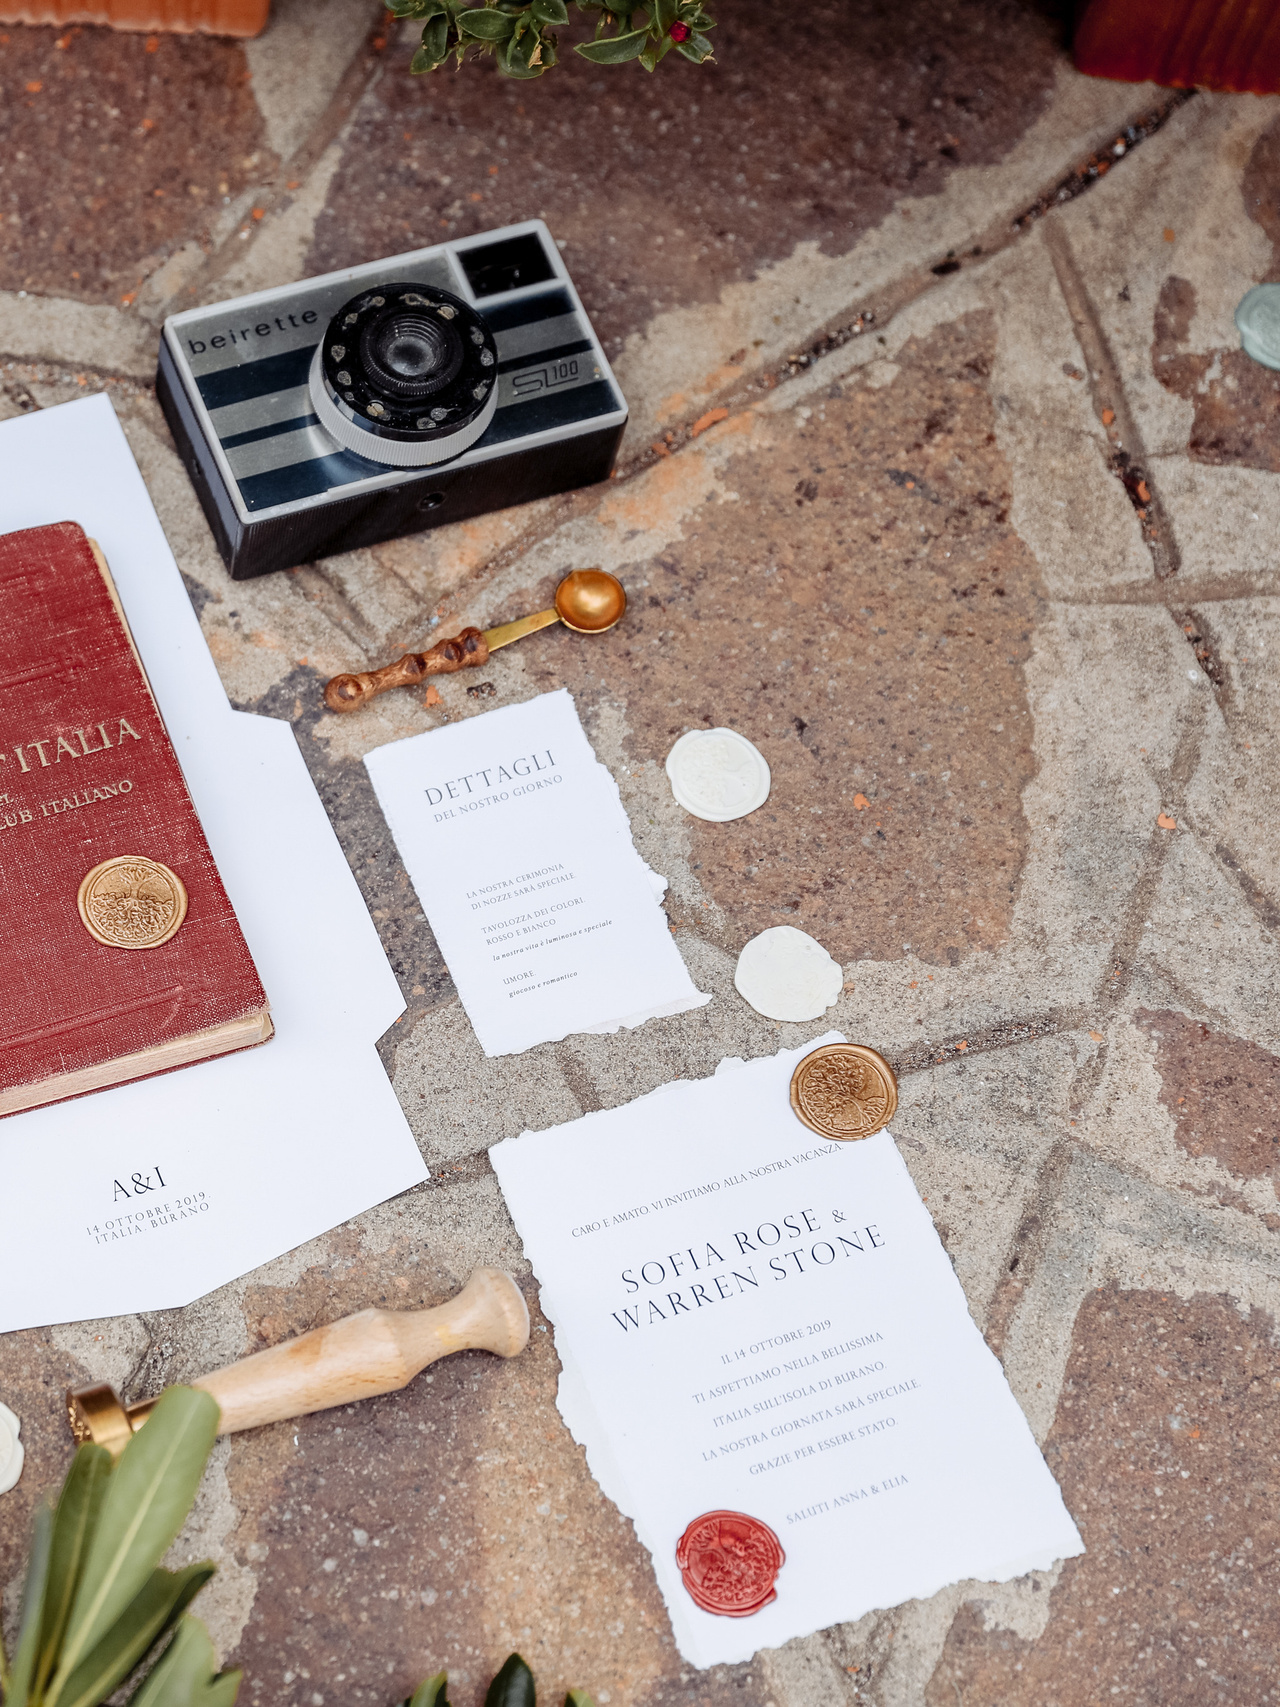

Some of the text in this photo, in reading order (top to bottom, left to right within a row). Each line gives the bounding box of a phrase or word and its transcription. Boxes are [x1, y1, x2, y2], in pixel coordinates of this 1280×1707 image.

[188, 310, 319, 355] beirette
[40, 779, 134, 818] ITALIANO
[423, 749, 556, 807] DETTAGLI
[433, 774, 563, 823] DEL NOSTRO GIORNO
[465, 863, 565, 899] LA NOSTRA CERIMONIA
[470, 901, 482, 911] DI
[482, 891, 513, 907] NOZZE
[513, 883, 537, 897] SARÀ
[480, 913, 533, 934] TAVOLOZZA
[533, 907, 549, 918] DEI
[485, 918, 557, 946] ROSSO E BIANCO
[492, 954, 501, 962] la
[524, 943, 539, 951] vita
[539, 939, 545, 947] è
[545, 931, 578, 945] luminosa
[583, 919, 613, 934] speciale
[508, 984, 536, 999] giocoso
[542, 971, 578, 987] romantico
[113, 1165, 167, 1203] A&I
[571, 1221, 601, 1238] CARO
[602, 1218, 611, 1228] E
[650, 1200, 664, 1211] VI
[664, 1181, 721, 1207] INVITIAMO
[723, 1173, 748, 1188] ALLA
[748, 1159, 792, 1180] NOSTRA
[86, 1224, 100, 1236] 14
[104, 1203, 172, 1230] OTTOBRE
[150, 1202, 210, 1229] BURANO
[621, 1208, 847, 1294] SOFIA ROSE &
[612, 1224, 886, 1332] WARREN STONE
[720, 1319, 832, 1365] IL 14 OTTOBRE 2019
[691, 1331, 884, 1404] TI ASPETTIAMO NELLA BELLISSIMA
[712, 1407, 752, 1428] ITALIA
[752, 1384, 817, 1414] SULL'ISOLA
[817, 1378, 833, 1391] DI
[701, 1449, 718, 1462] LA
[719, 1431, 769, 1456] NOSTRA
[770, 1409, 834, 1437] GIORNATA
[834, 1397, 866, 1416] SARÀ
[748, 1452, 793, 1475] GRAZIE
[793, 1445, 817, 1460] PER
[817, 1430, 857, 1452] ESSERE
[785, 1474, 909, 1525] SALUTI ANNA & ELIA
